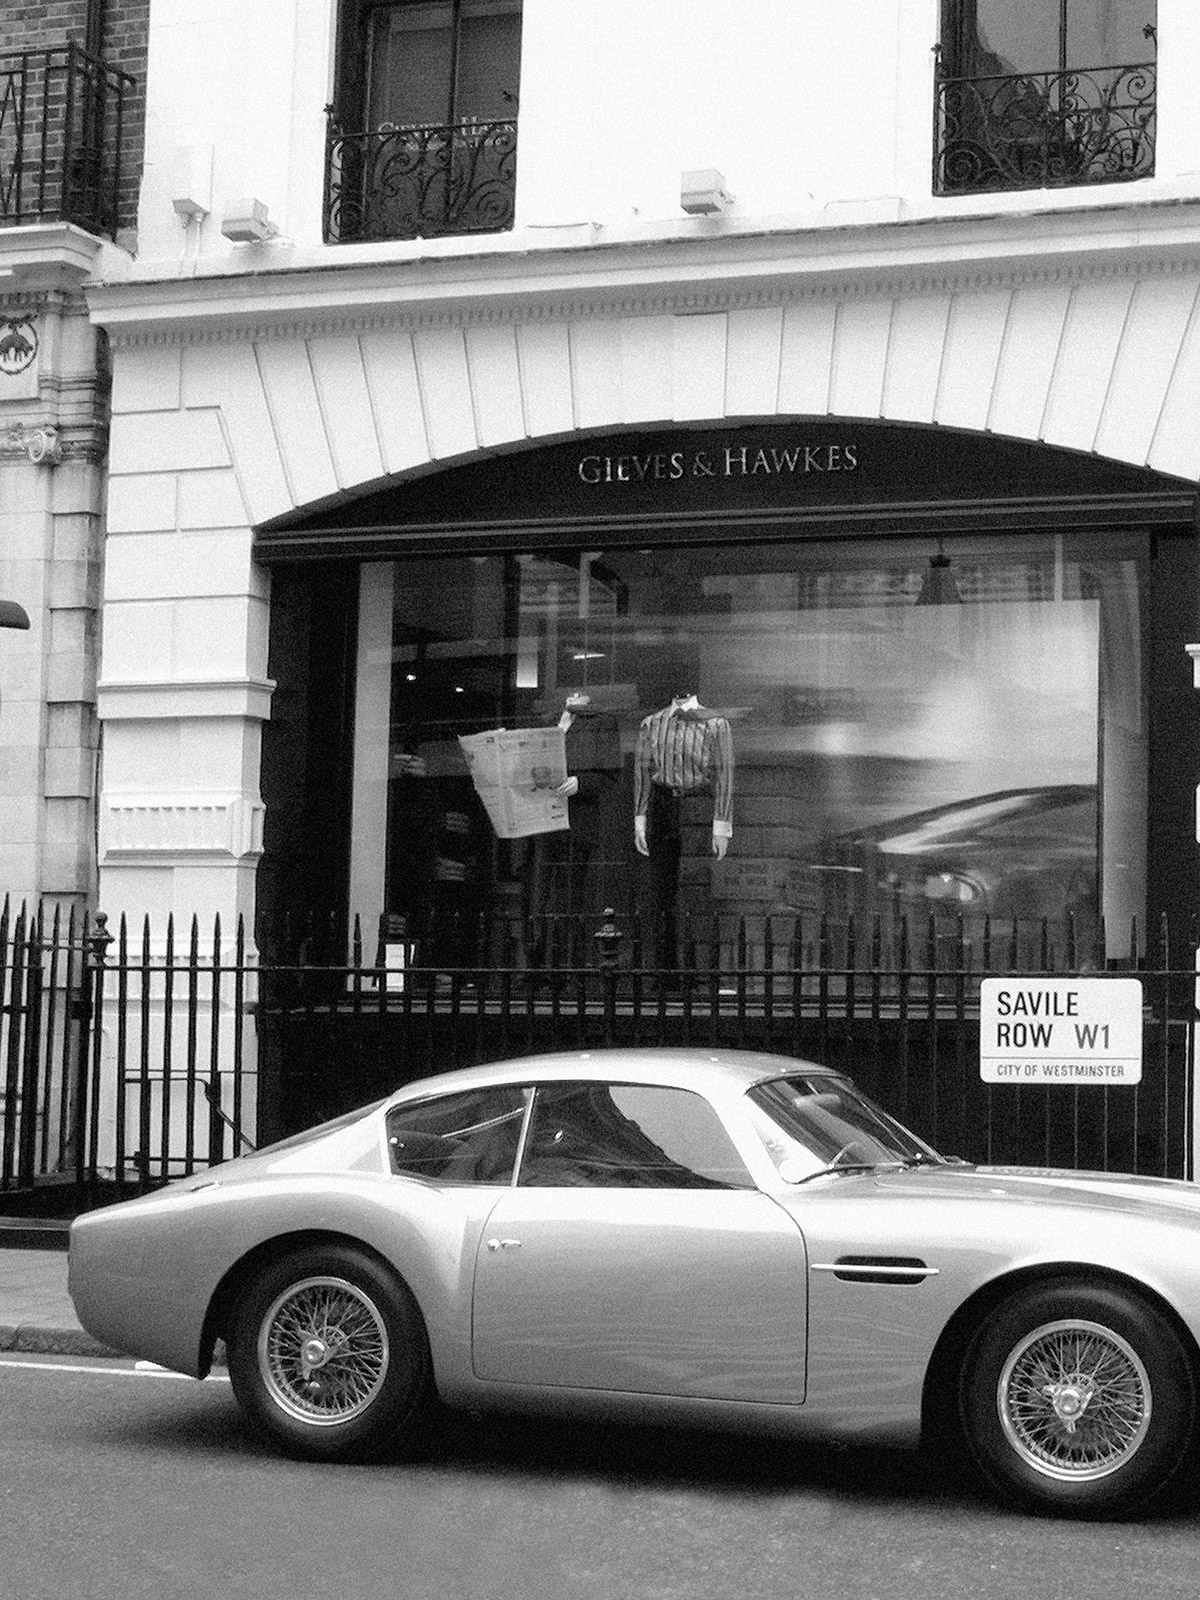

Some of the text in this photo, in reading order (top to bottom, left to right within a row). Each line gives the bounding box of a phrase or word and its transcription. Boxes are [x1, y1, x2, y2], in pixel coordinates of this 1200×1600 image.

[578, 445, 858, 484] GIEVES & HAWKES
[996, 991, 1080, 1017] SAVILE
[996, 1022, 1111, 1050] ROW W1
[997, 1064, 1125, 1078] CITY OF WESTMINSTER
